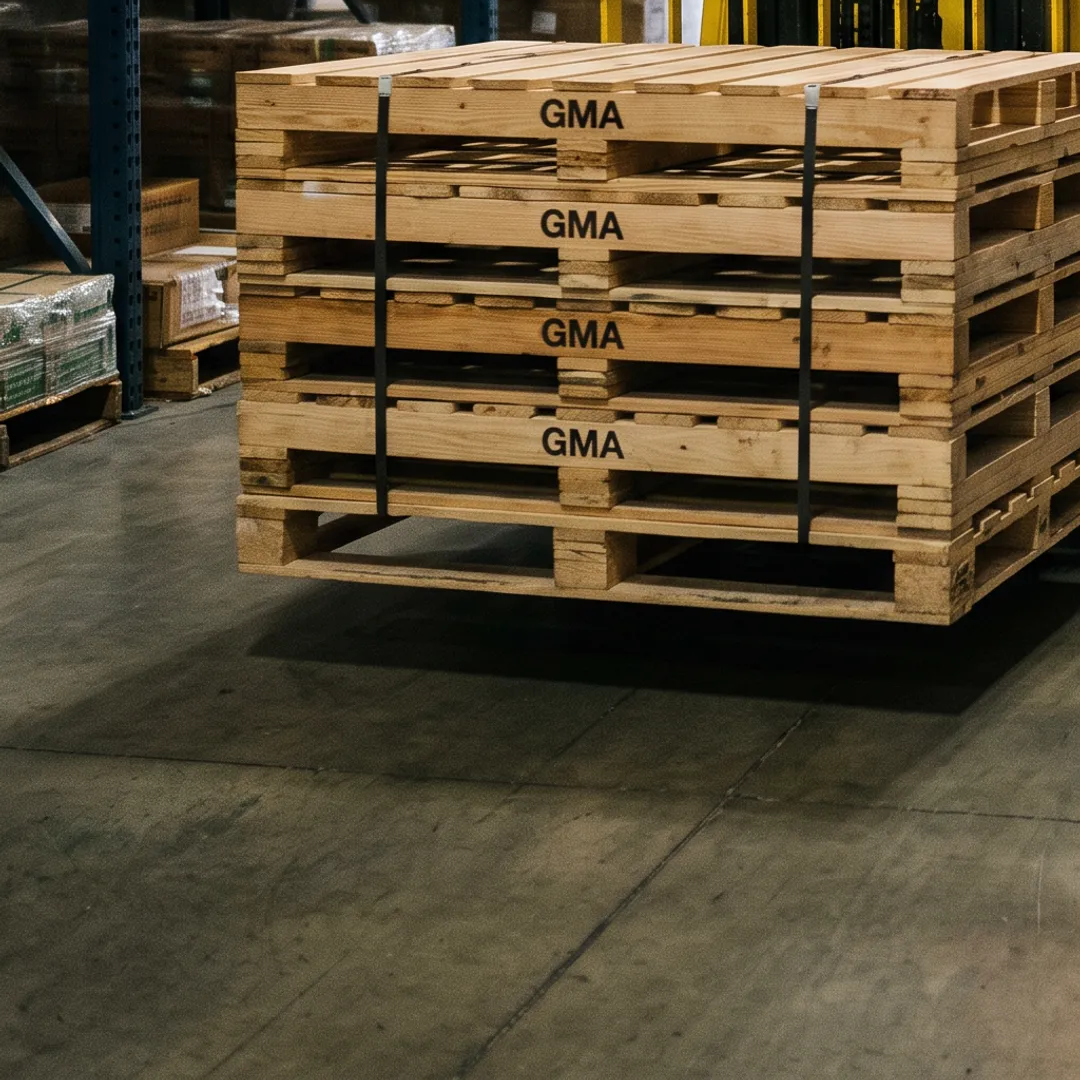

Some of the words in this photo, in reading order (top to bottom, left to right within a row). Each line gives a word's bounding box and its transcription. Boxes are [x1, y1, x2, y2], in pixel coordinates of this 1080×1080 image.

[539, 98, 625, 130] GMA
[540, 208, 624, 241] GMA
[540, 317, 625, 351] GMA
[541, 426, 625, 460] GMA
